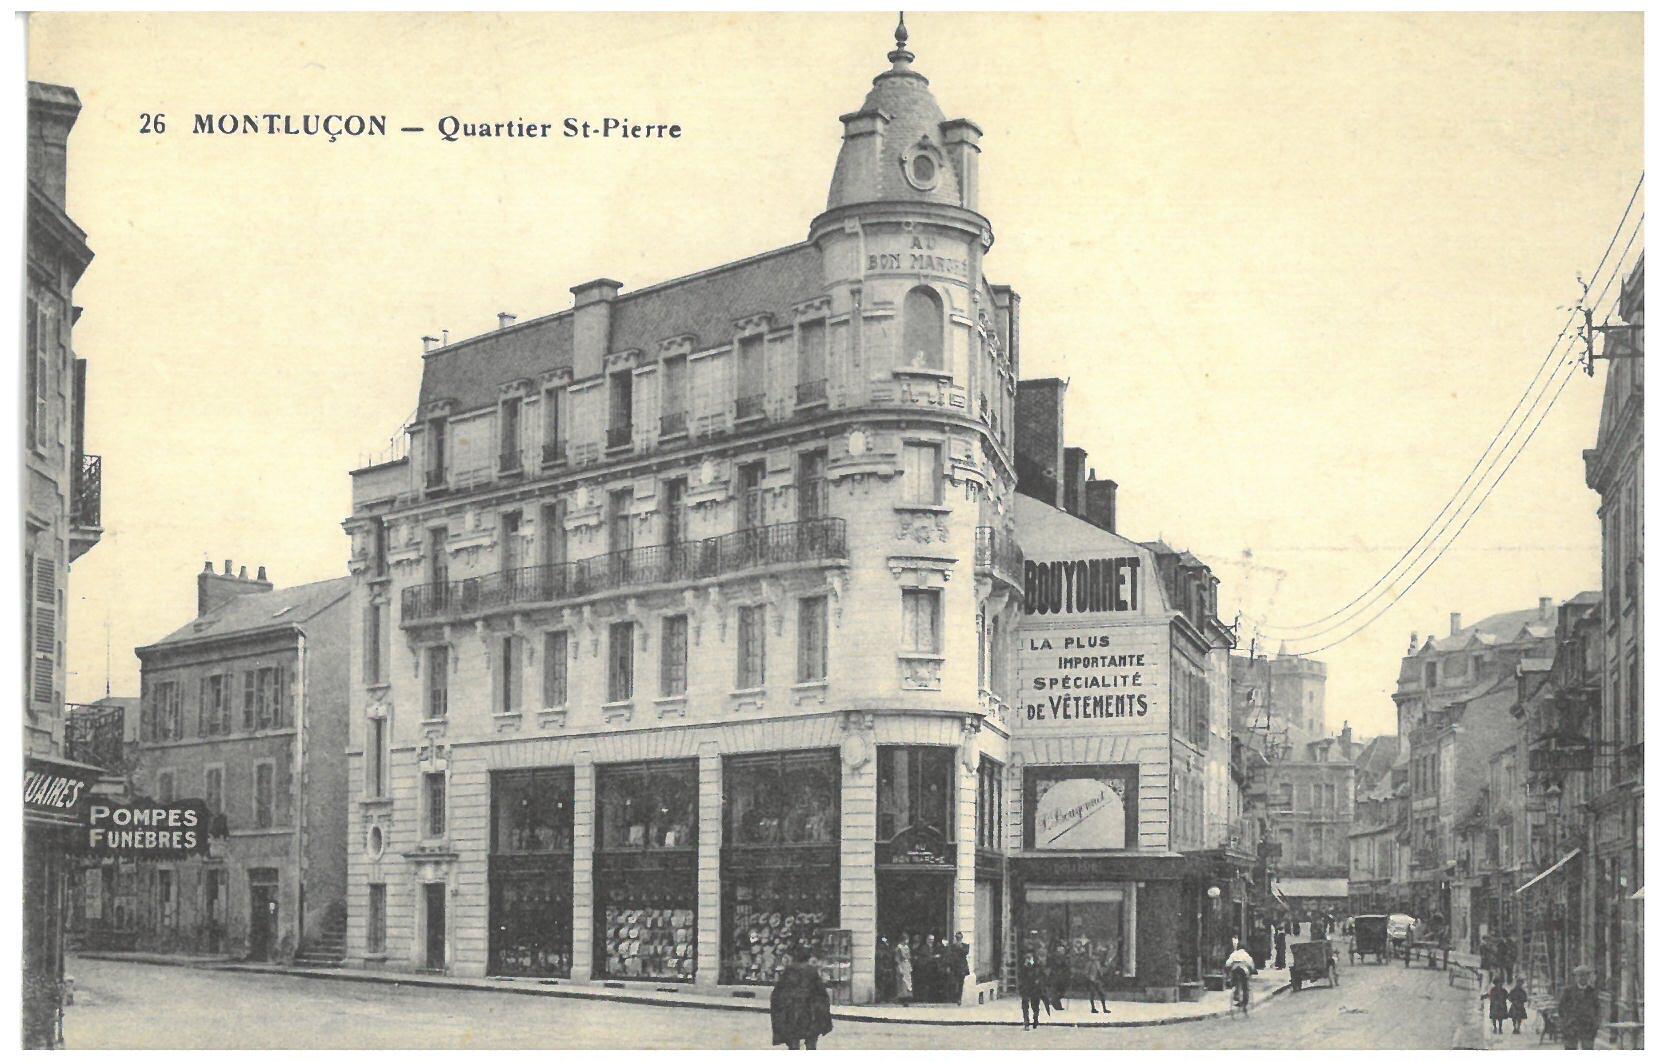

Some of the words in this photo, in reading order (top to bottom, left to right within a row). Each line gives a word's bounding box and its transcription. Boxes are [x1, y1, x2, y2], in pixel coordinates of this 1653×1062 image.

[910, 236, 936, 250] AU
[867, 253, 901, 271] BON
[1024, 557, 1140, 615] BOUYONNET
[1030, 638, 1053, 651] LA
[1065, 636, 1110, 650] PLUS
[1058, 654, 1145, 669] IMPORTANTE
[1033, 672, 1142, 690] SPÉCIALITÉ
[1027, 703, 1045, 720] DE
[1048, 693, 1148, 719] VÊTEMENTS
[90, 806, 198, 827] POMPES
